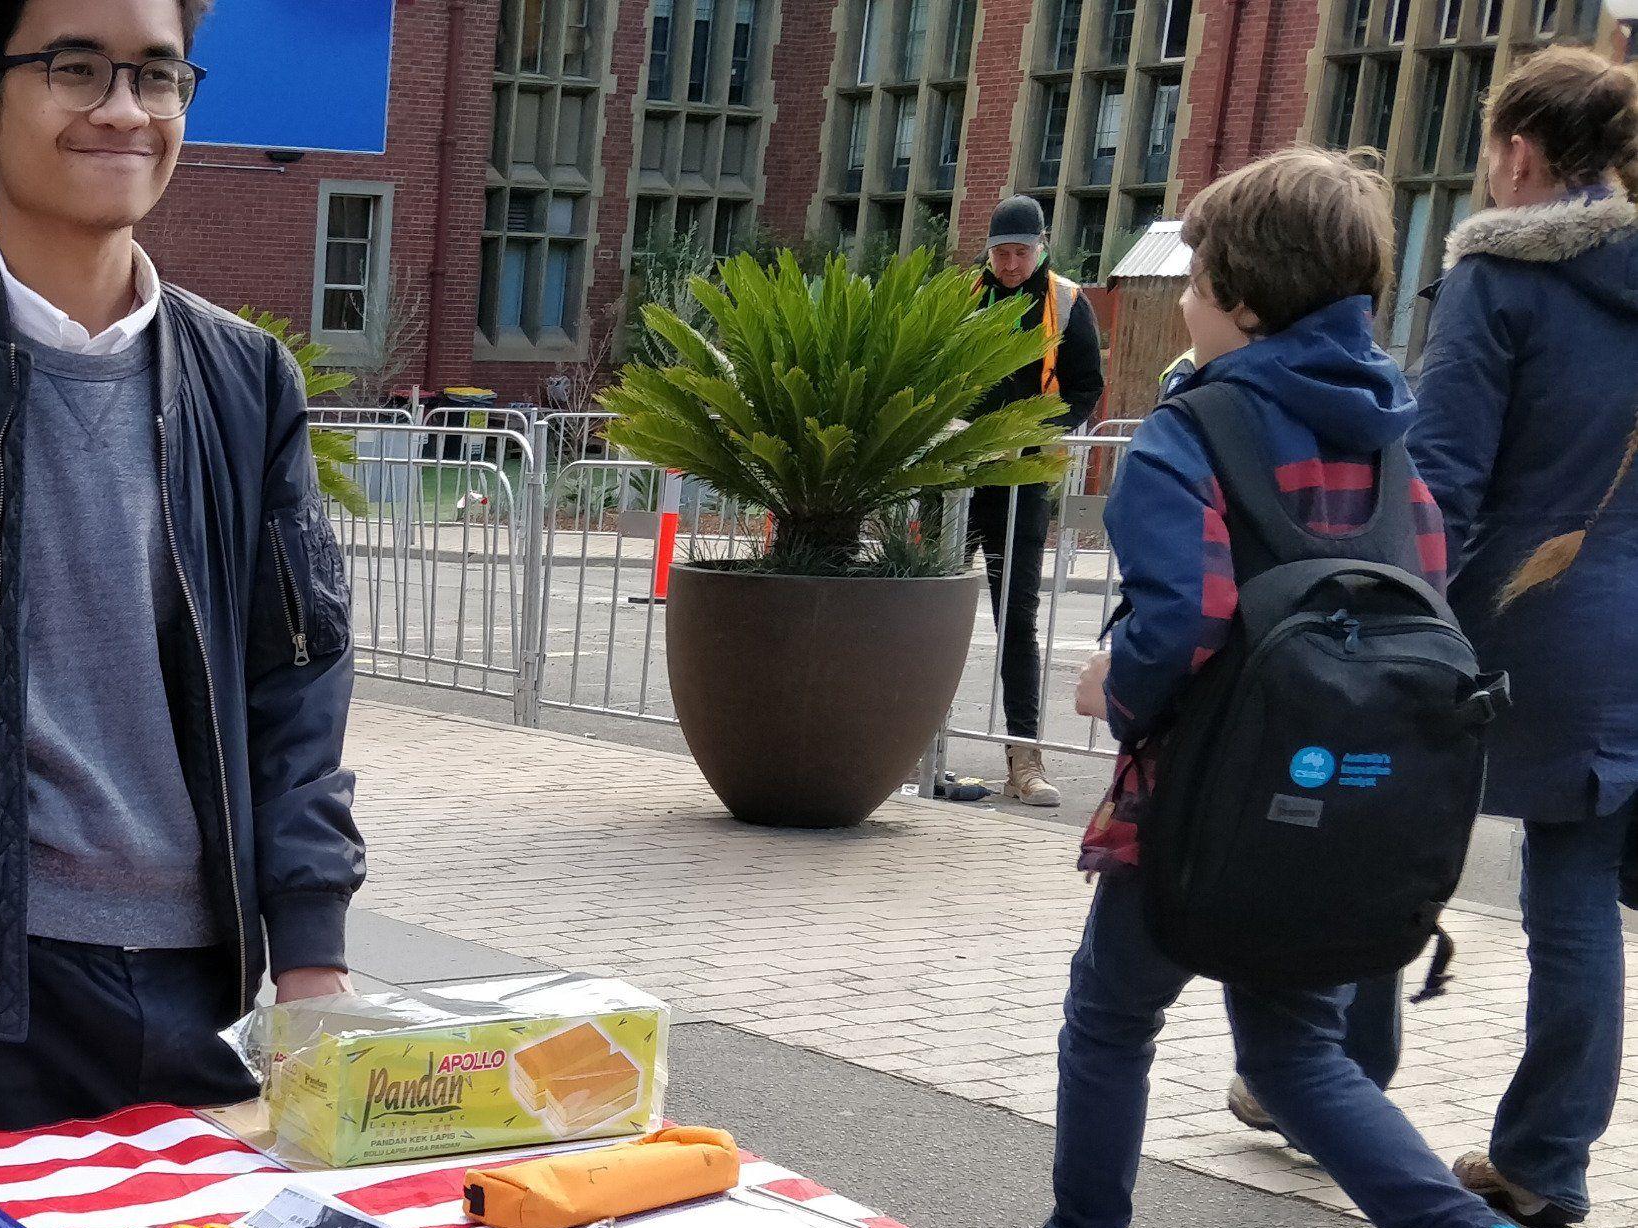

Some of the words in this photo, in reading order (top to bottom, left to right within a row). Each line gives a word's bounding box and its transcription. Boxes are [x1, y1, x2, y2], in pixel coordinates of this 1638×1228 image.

[437, 1050, 506, 1074] APOLLO
[360, 1052, 464, 1133] Pandan
[370, 1137, 408, 1147] PANDAN
[409, 1135, 428, 1144] KEK
[430, 1132, 456, 1142] LAPIS
[408, 1145, 429, 1153] RASA
[430, 1142, 461, 1151] PANDAN
